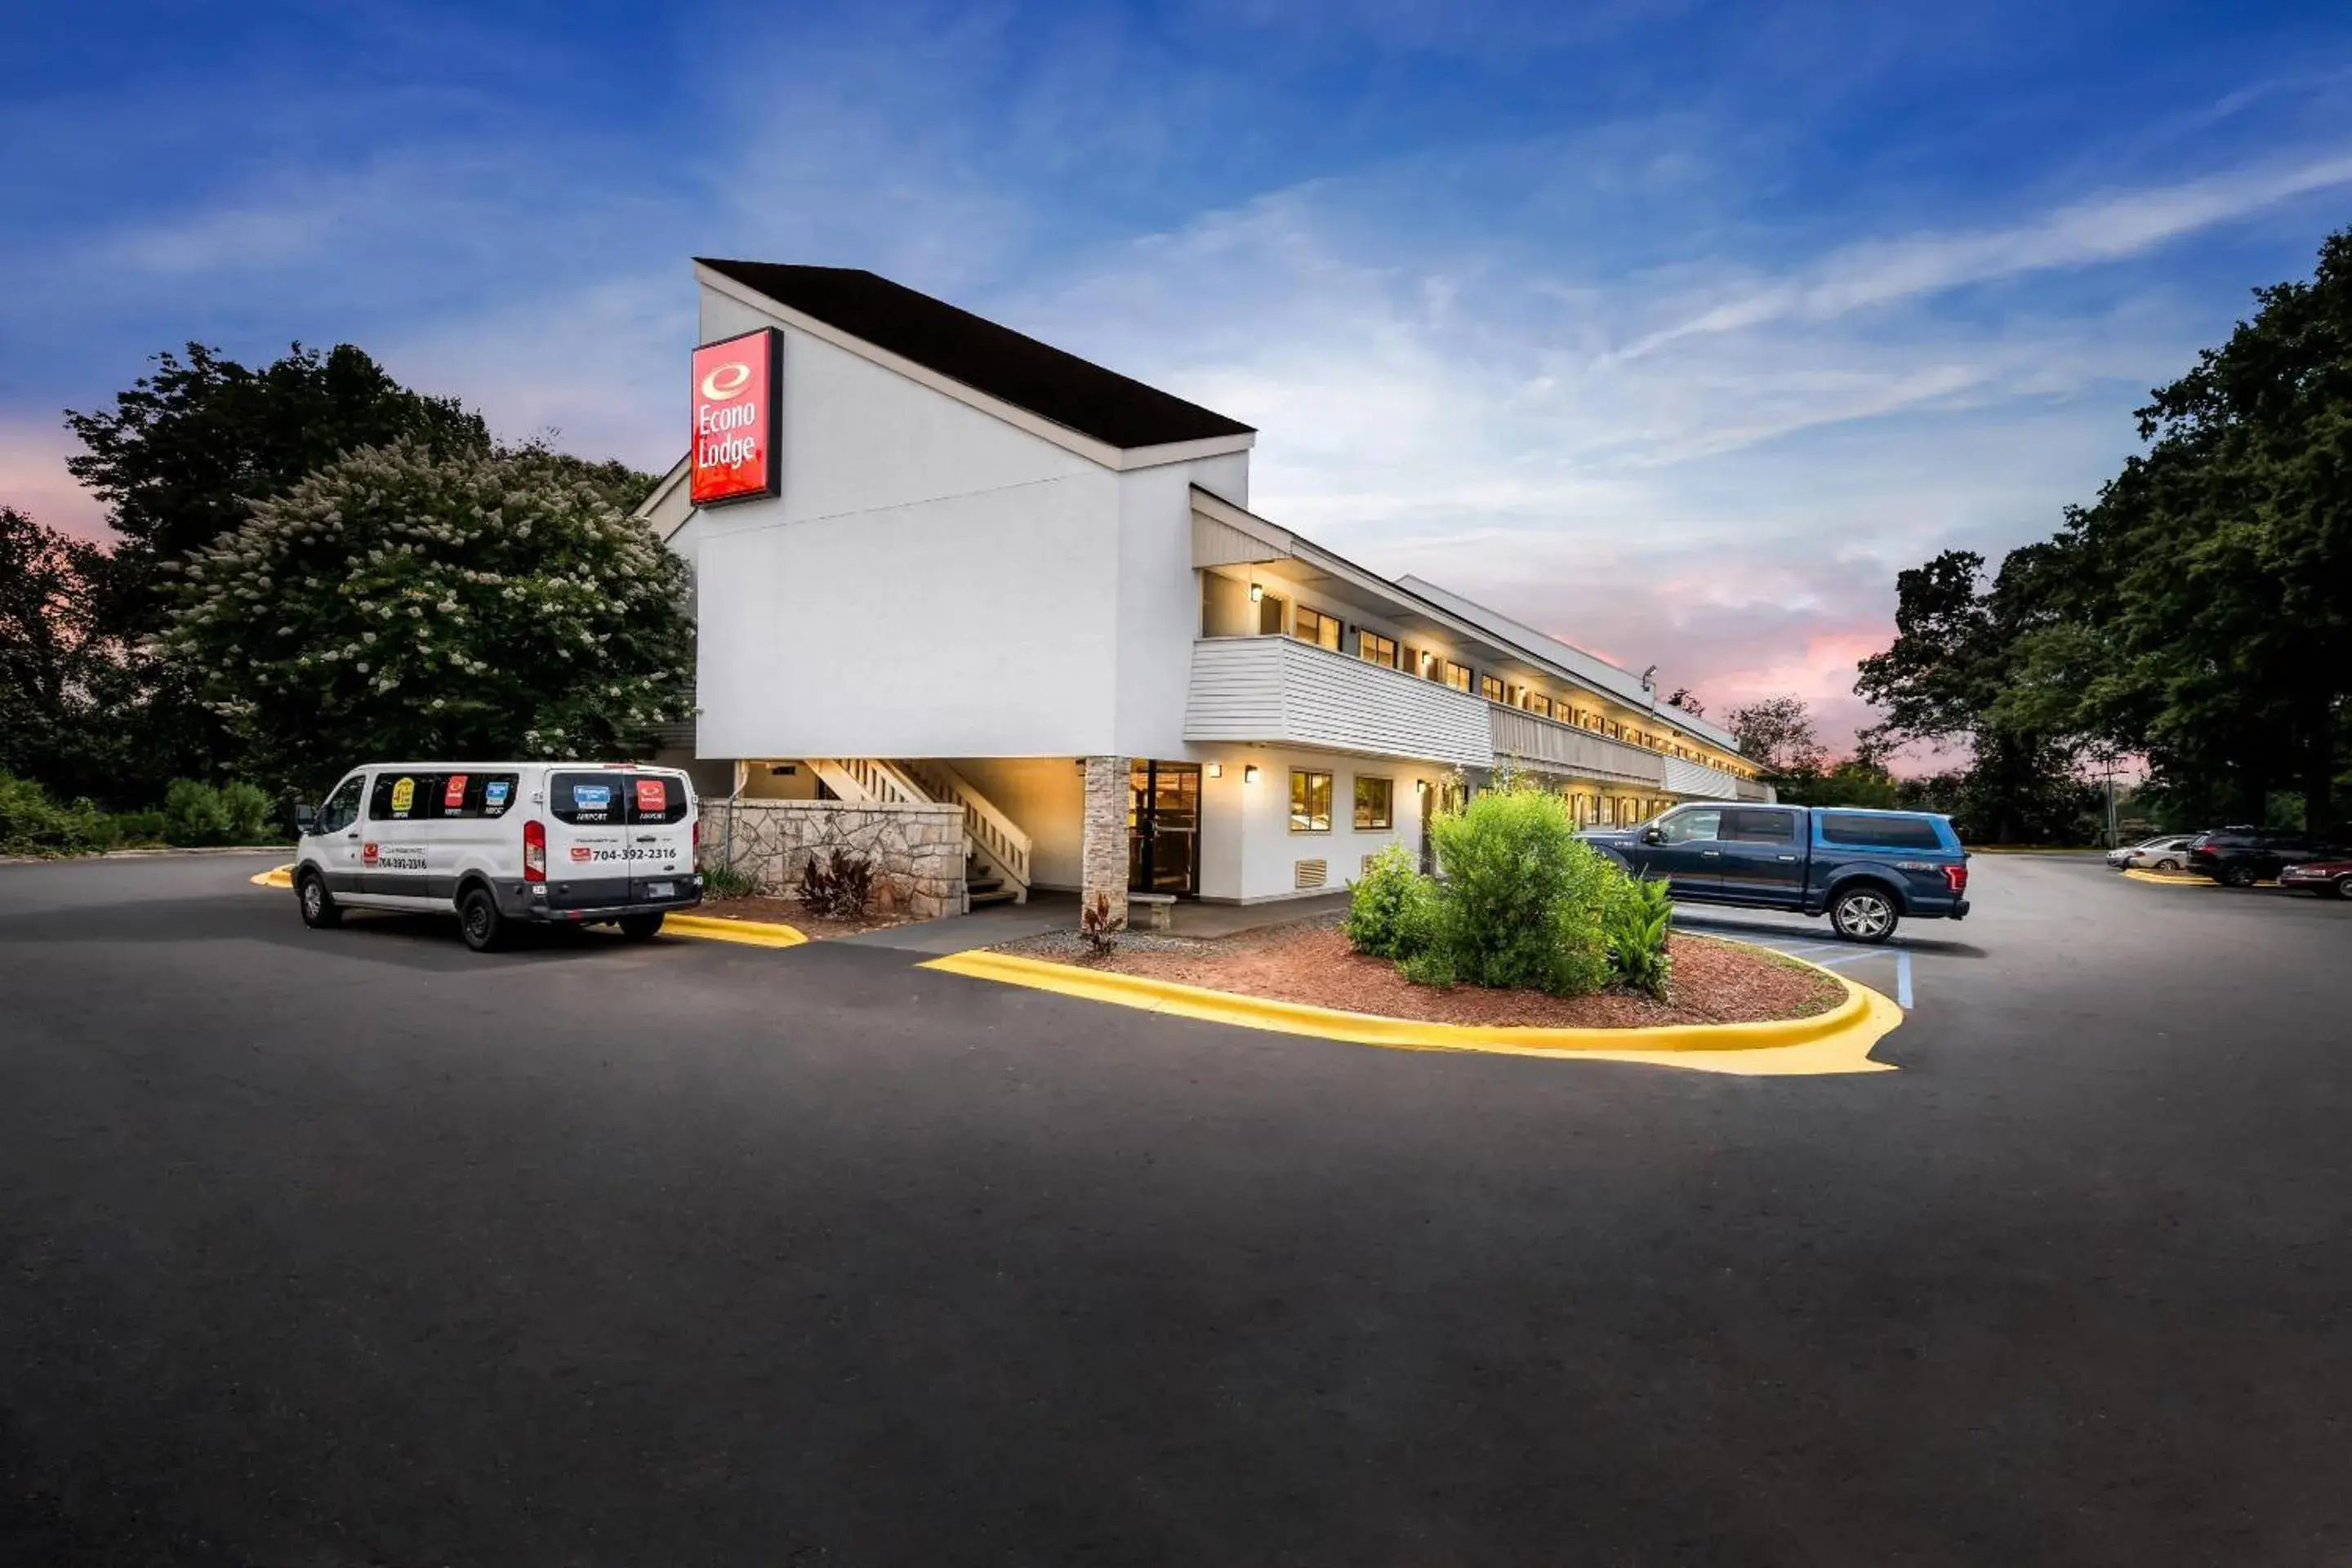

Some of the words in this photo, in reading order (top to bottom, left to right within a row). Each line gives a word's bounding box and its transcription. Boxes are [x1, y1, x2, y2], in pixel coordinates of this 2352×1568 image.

[700, 402, 755, 434] Econo
[698, 434, 755, 470] Lodge
[593, 849, 676, 861] 704-392-2316
